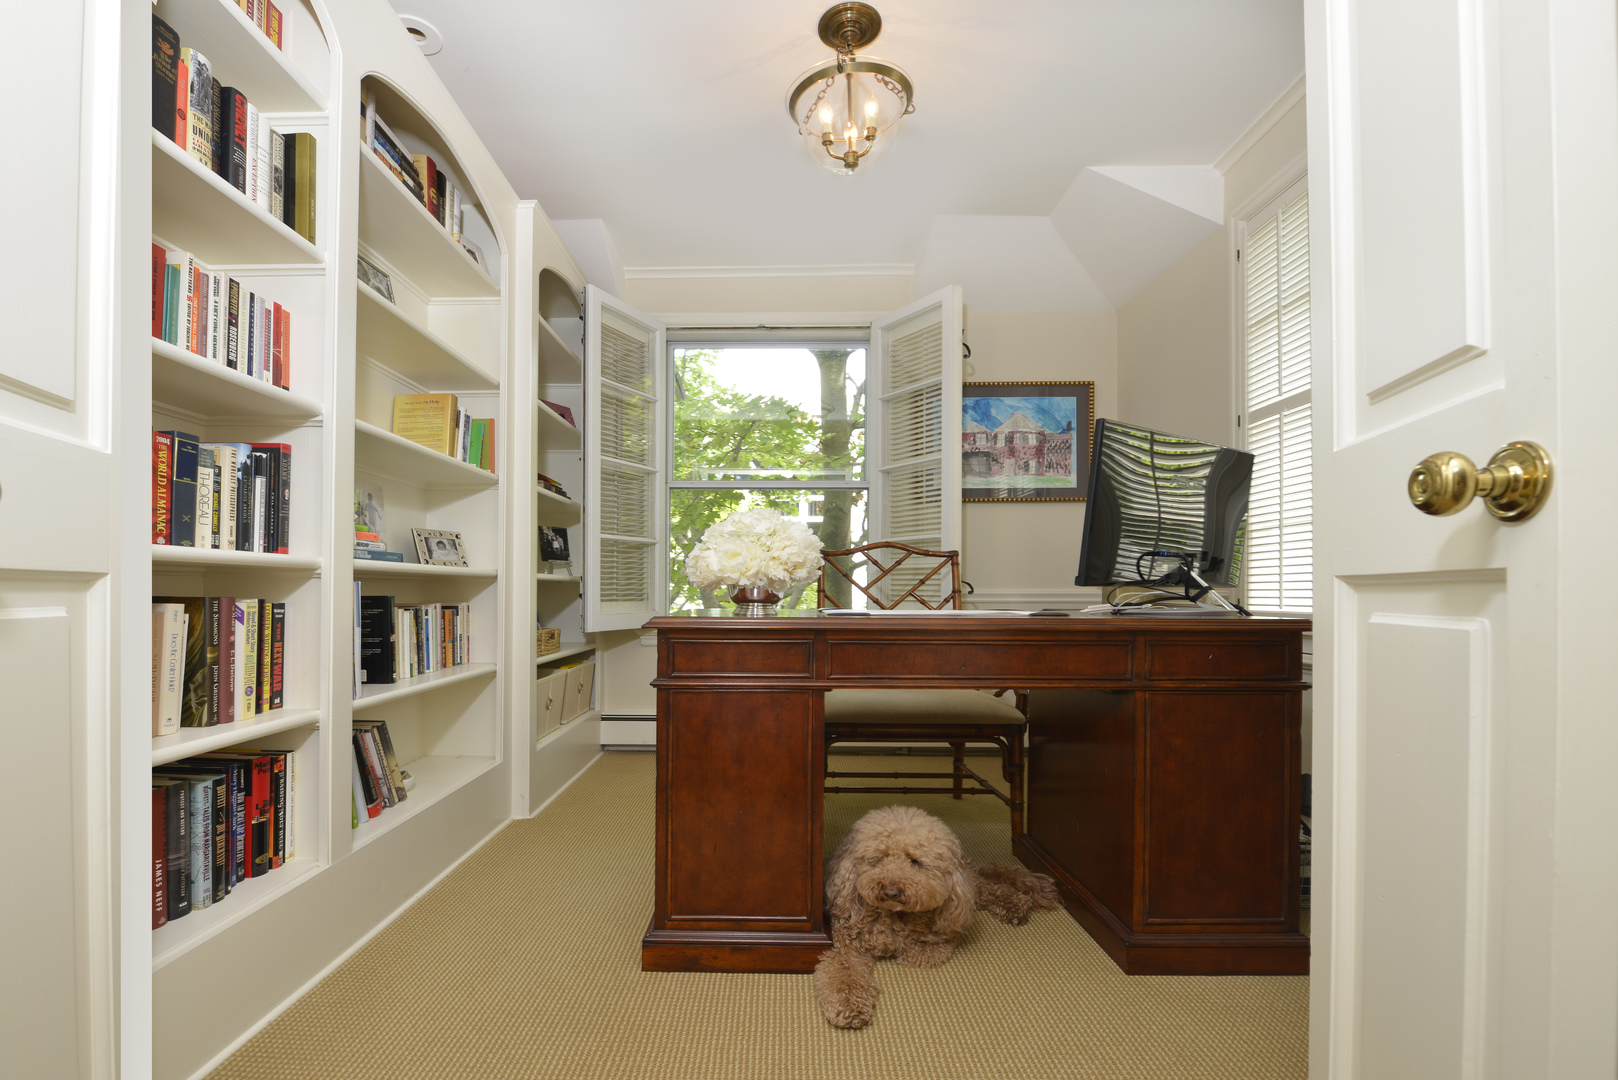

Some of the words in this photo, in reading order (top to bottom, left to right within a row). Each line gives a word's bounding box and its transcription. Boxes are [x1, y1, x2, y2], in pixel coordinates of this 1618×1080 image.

[193, 113, 204, 124] THE
[234, 93, 247, 151] CHENEY
[230, 282, 238, 314] EPICENTER
[229, 326, 238, 362] ROSENBERG
[156, 436, 170, 445] 2004
[158, 450, 168, 485] WORLD
[156, 486, 166, 534] ALMANAC
[198, 471, 210, 526] THOREAU
[274, 642, 283, 664] NEXT
[169, 658, 178, 676] Center
[273, 664, 282, 692] WAR
[168, 676, 177, 692] Hold?
[216, 784, 225, 808] BUFFETT
[237, 791, 246, 804] How
[226, 818, 232, 832] NO
[237, 824, 245, 835] the
[236, 835, 245, 863] Democrats
